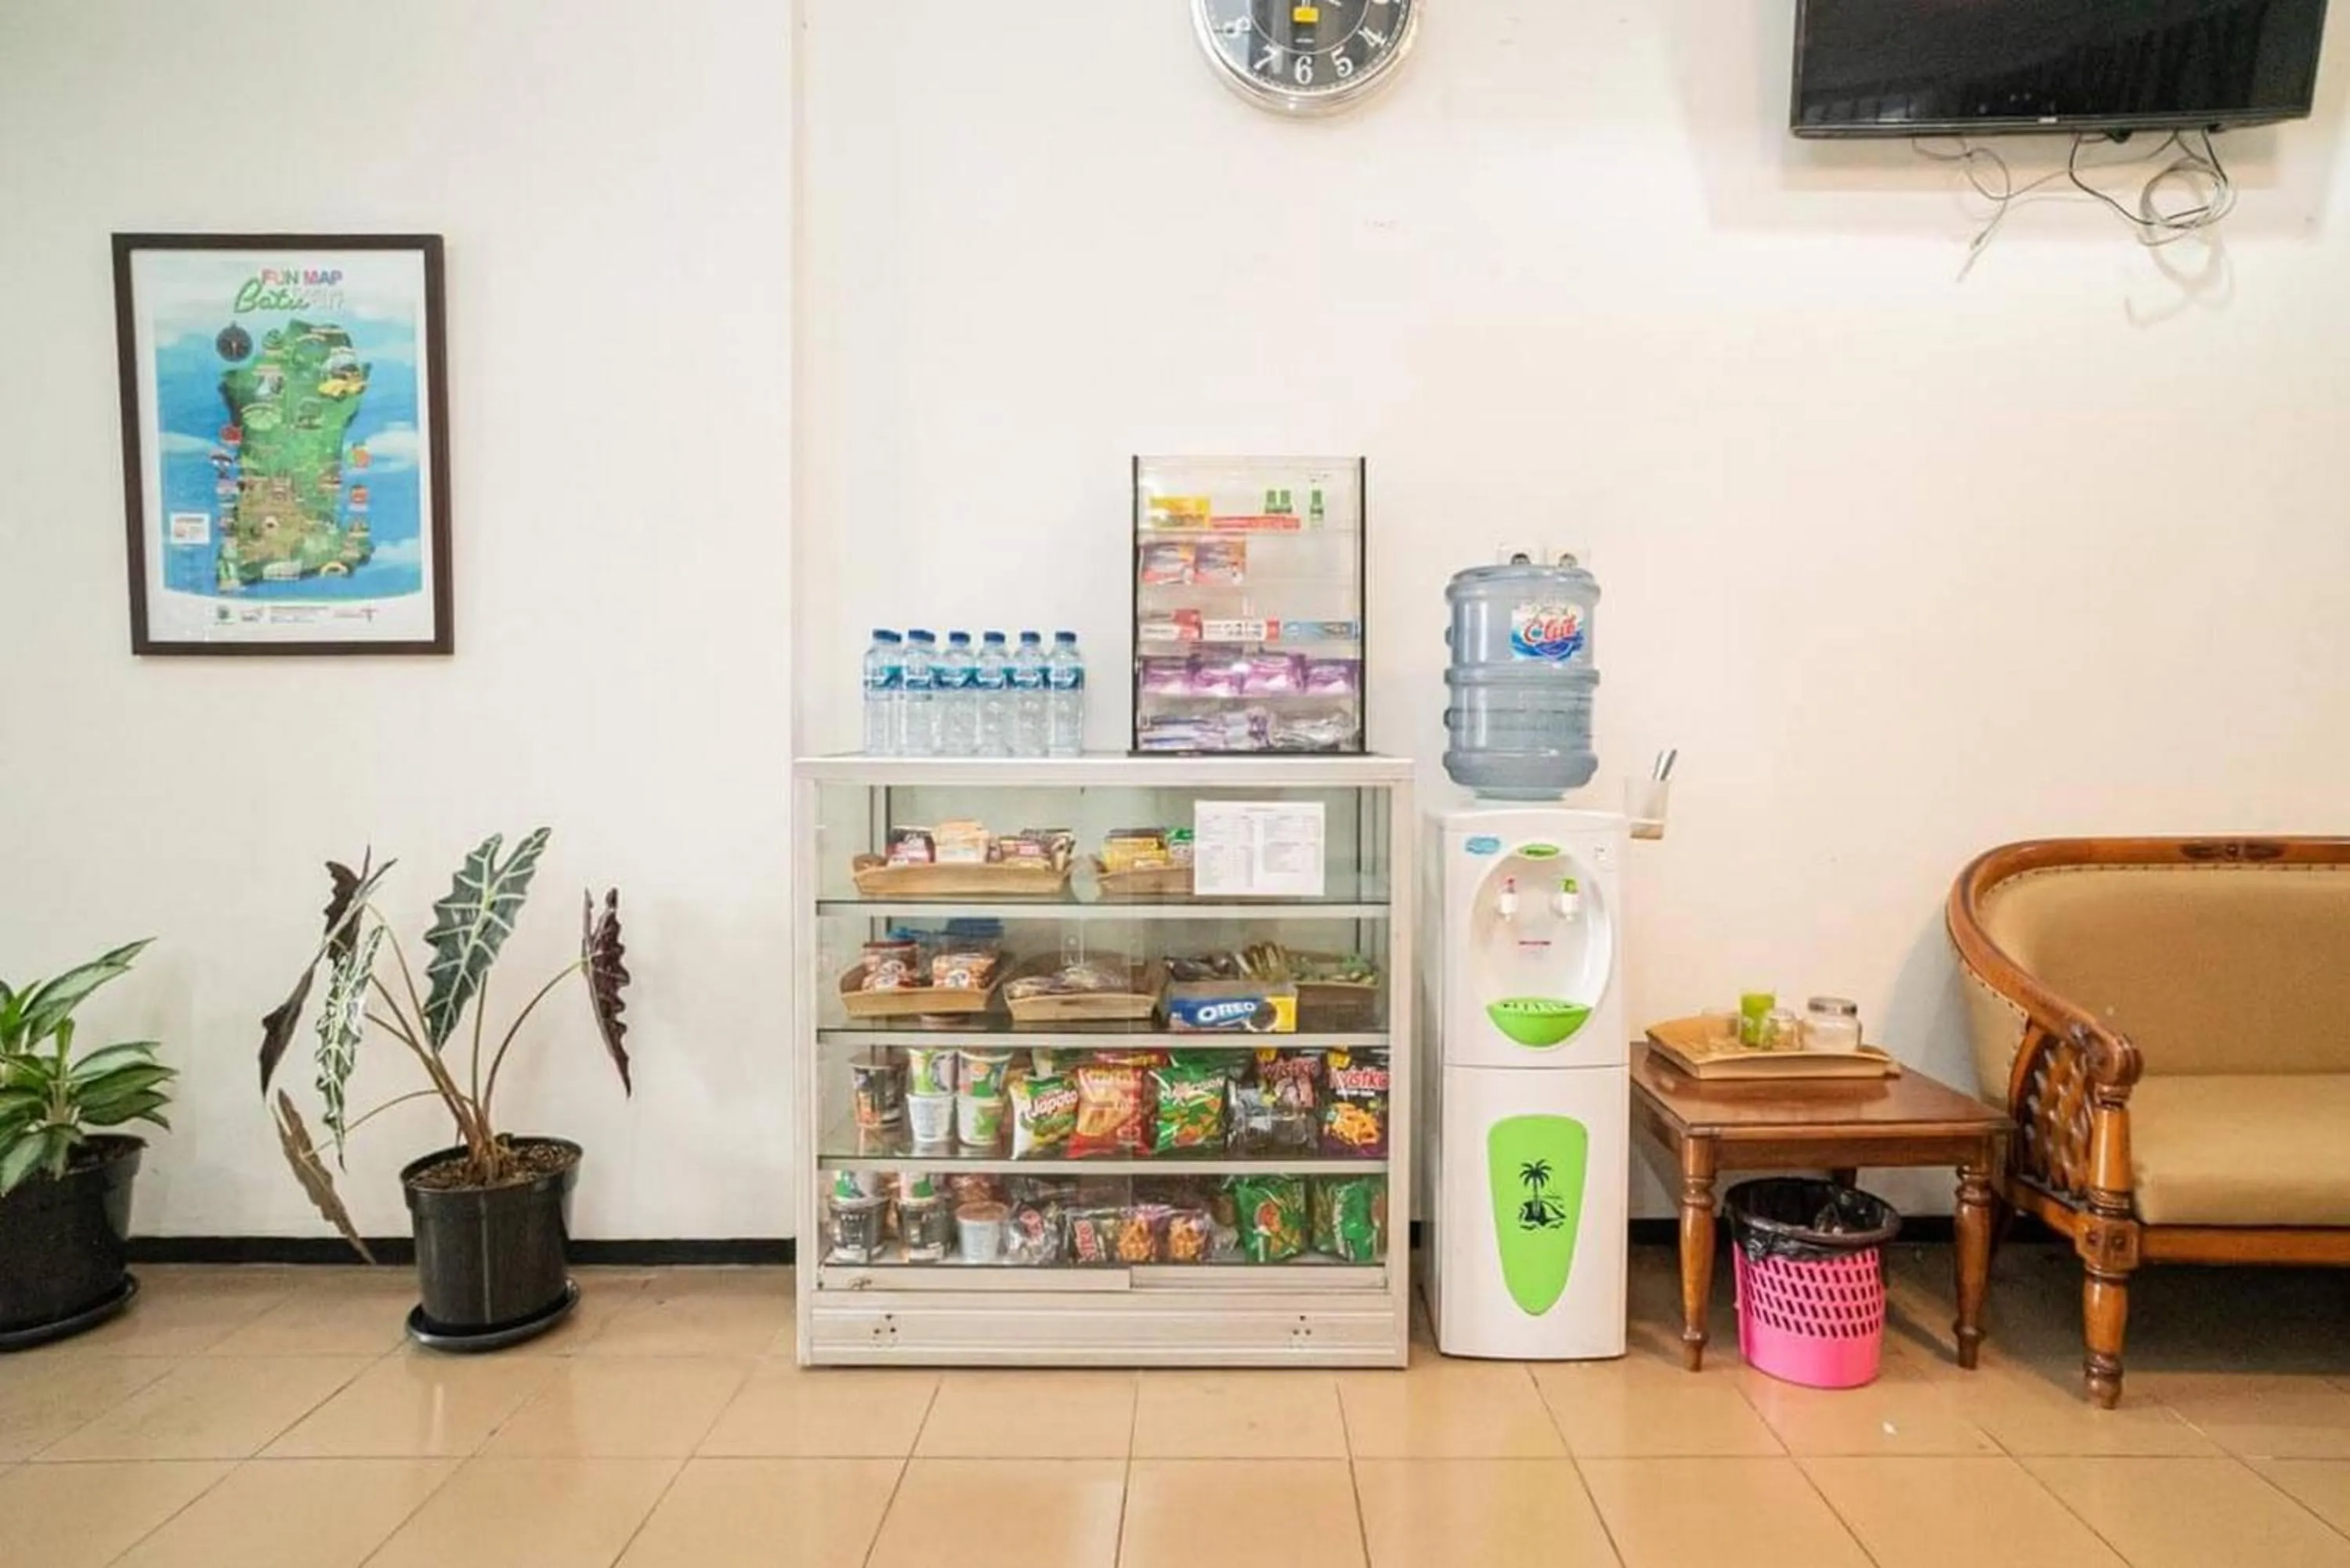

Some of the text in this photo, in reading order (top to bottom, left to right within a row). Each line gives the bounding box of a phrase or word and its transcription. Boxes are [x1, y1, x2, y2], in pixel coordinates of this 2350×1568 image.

[1223, 16, 1251, 38] 8
[1358, 26, 1387, 47] 4
[1254, 45, 1278, 70] 7
[1331, 45, 1354, 78] 5
[1295, 56, 1313, 85] 6
[303, 269, 343, 286] MAP
[233, 277, 310, 313] Batu
